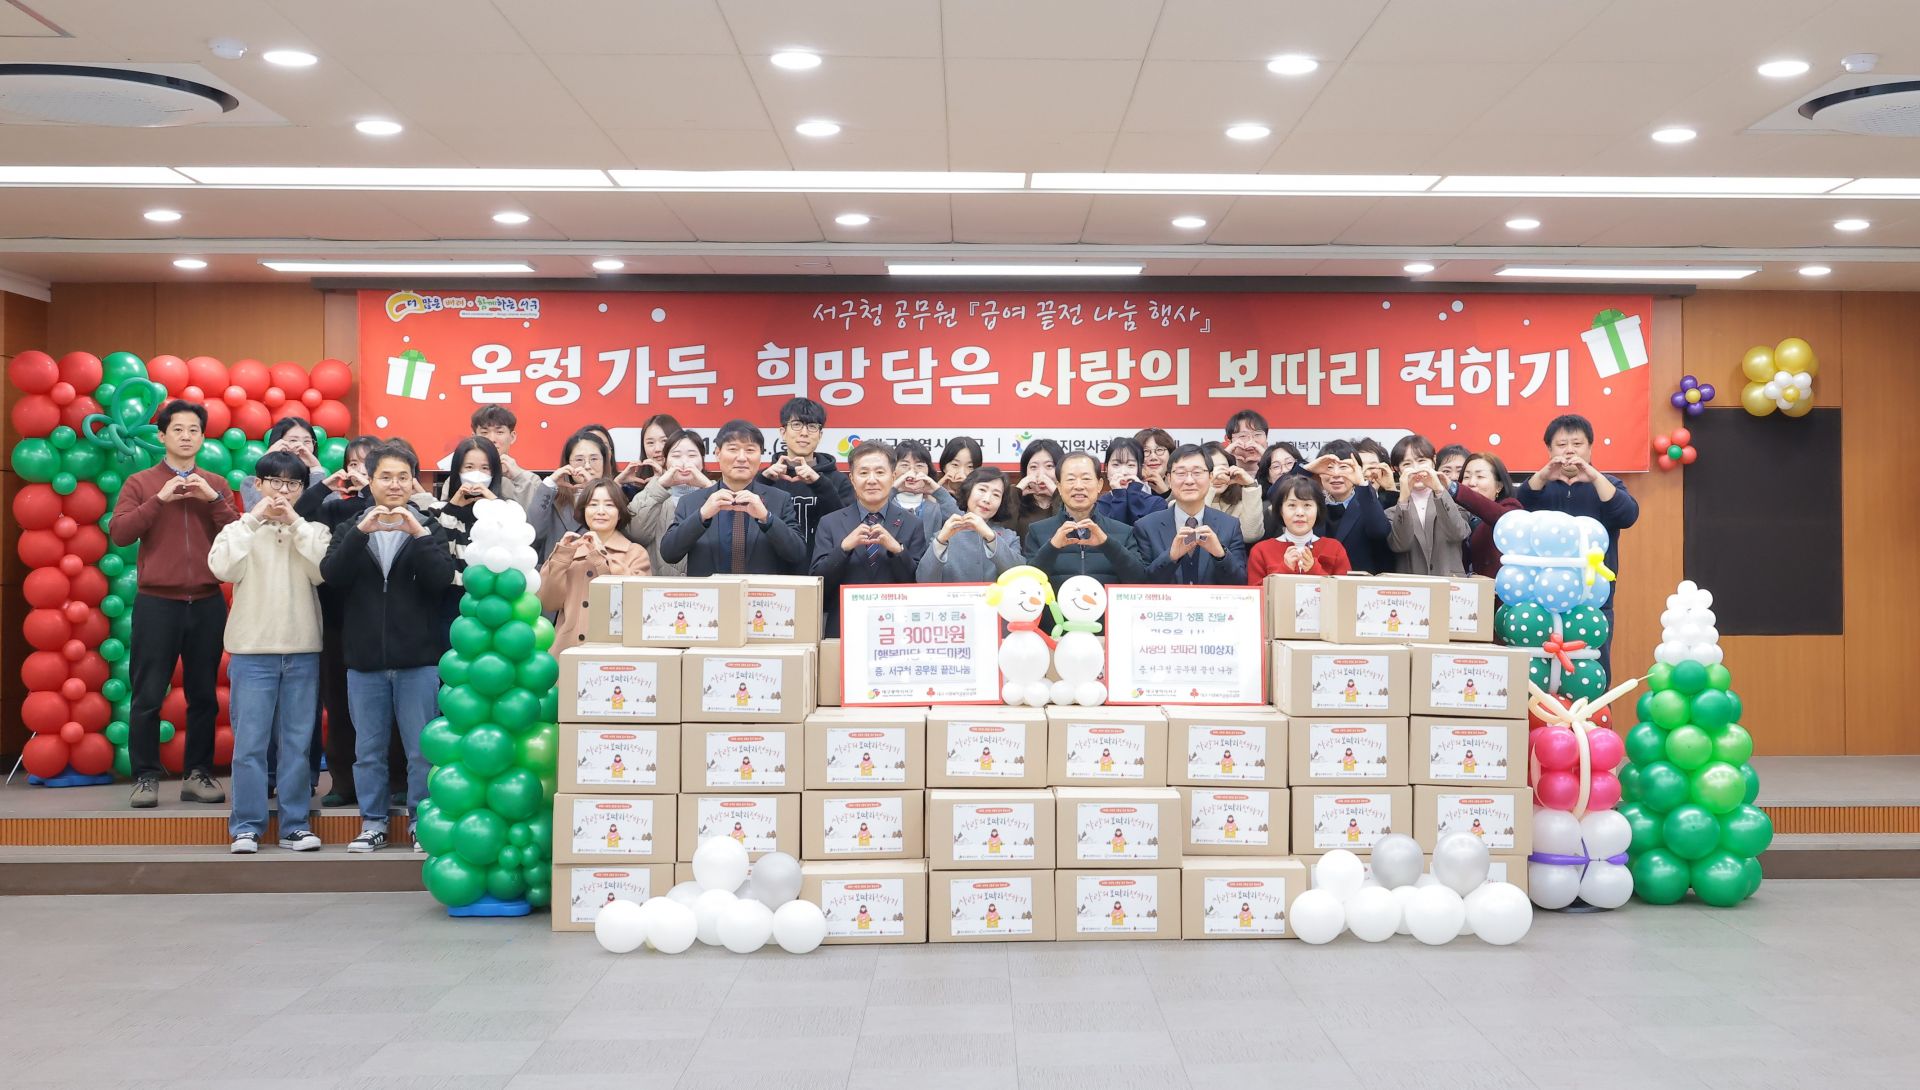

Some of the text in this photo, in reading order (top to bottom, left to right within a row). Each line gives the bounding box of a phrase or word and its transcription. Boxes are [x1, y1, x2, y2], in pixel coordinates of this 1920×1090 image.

[812, 299, 882, 330] 서구청
[895, 299, 958, 330] 공무원
[1036, 300, 1083, 330] 끝전
[1093, 300, 1138, 331] 나눔
[459, 342, 1570, 407] 온정 가득, 희망 담은 사랑의 보따리 전하기
[879, 625, 965, 645] 금 300만원
[1200, 645, 1233, 656] 100상자
